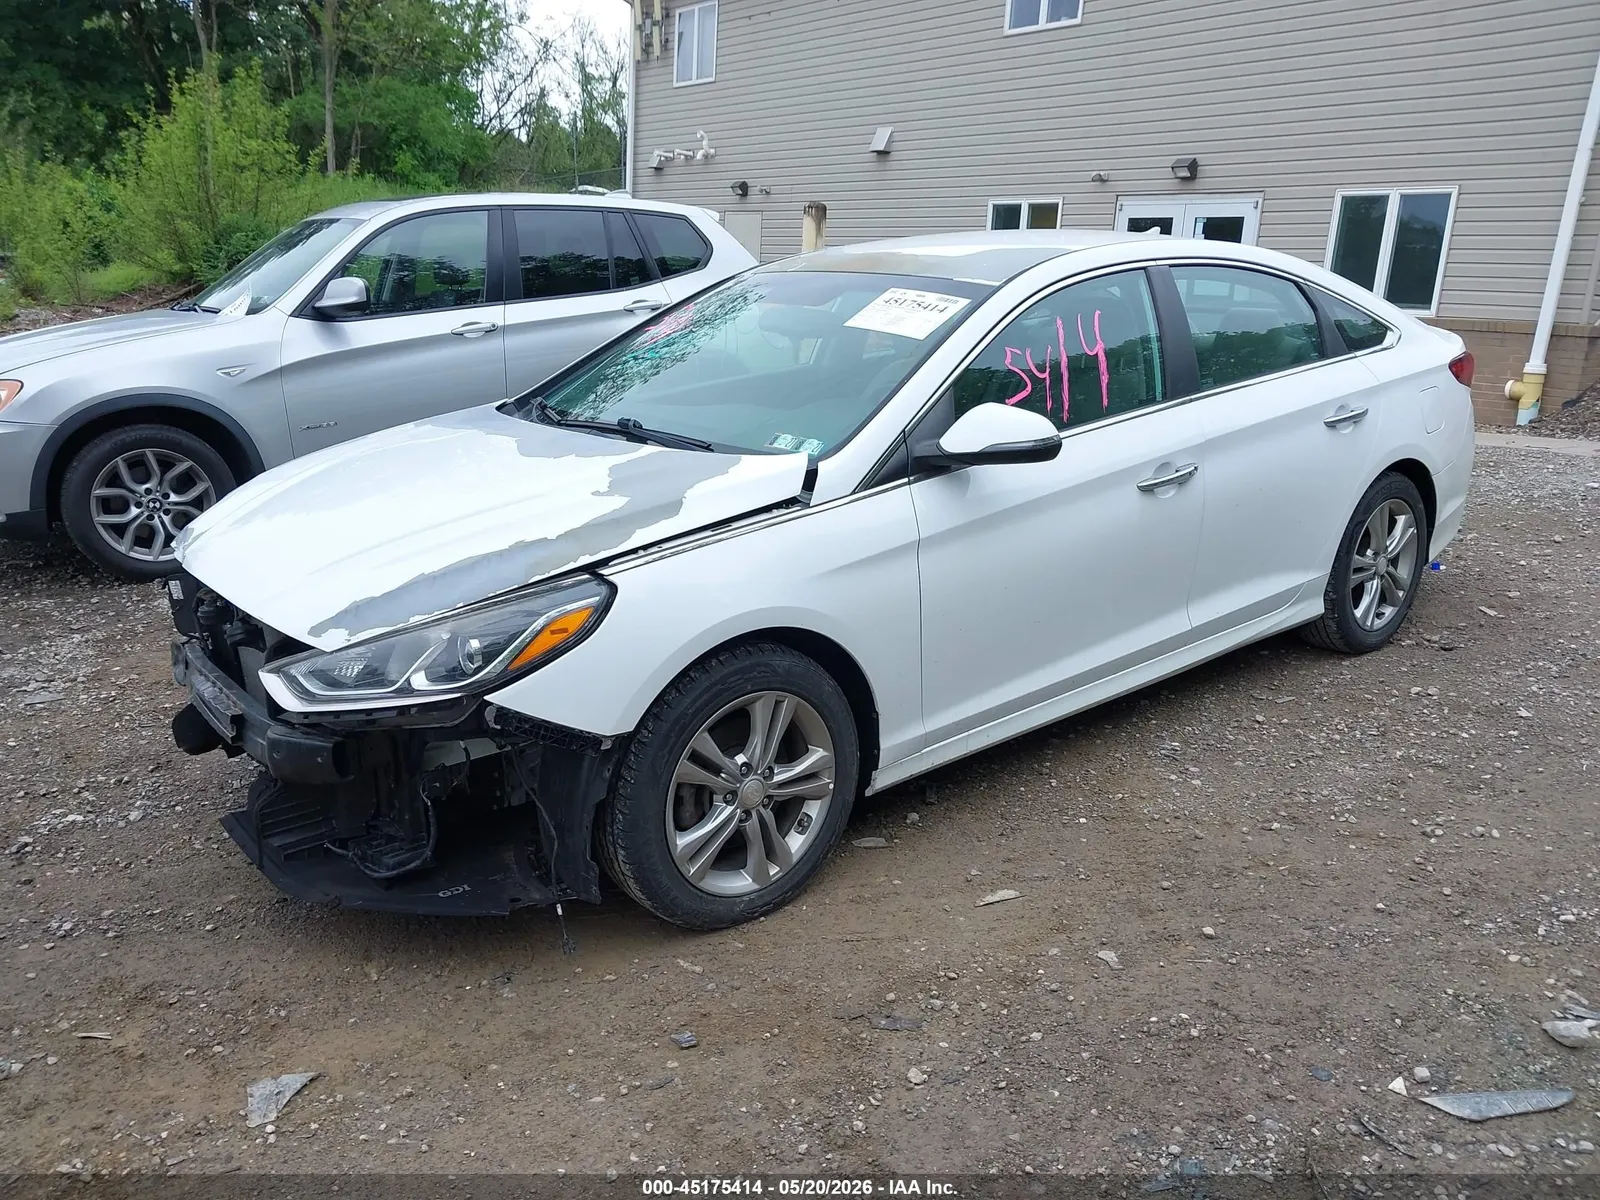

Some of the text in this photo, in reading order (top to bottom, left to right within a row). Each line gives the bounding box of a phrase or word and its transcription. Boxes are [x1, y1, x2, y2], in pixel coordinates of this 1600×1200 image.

[882, 295, 950, 314] 45175414
[1004, 309, 1110, 424] 5414
[438, 884, 472, 898] GDI
